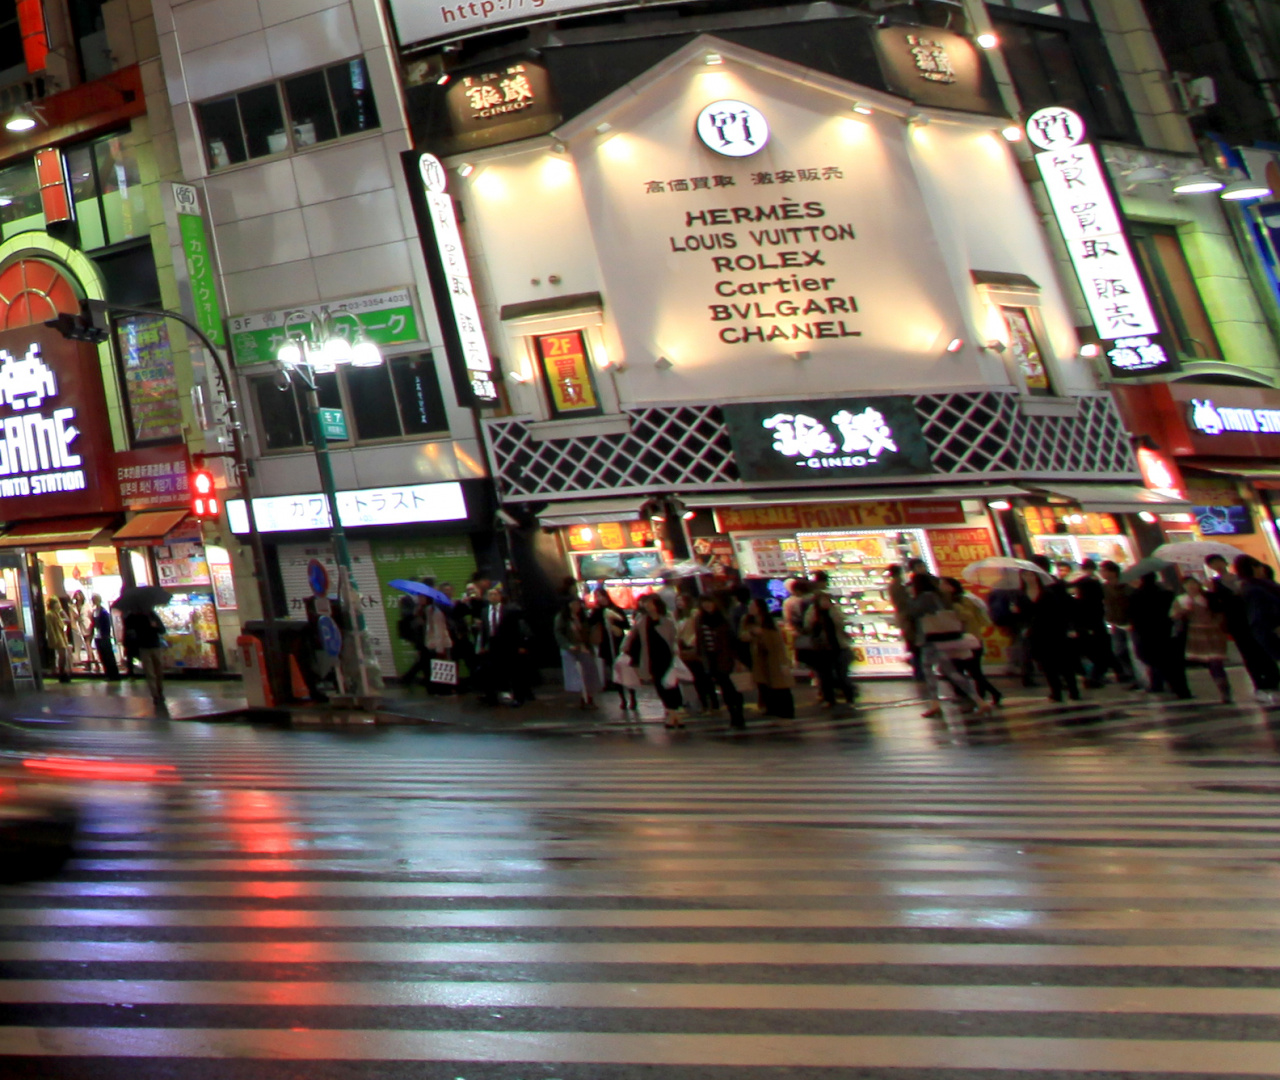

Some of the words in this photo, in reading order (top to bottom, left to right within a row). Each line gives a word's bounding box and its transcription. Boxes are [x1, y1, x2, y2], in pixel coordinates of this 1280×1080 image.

[644, 174, 736, 195] 高価買取
[750, 165, 844, 186] 激安販売
[685, 196, 826, 227] HERMÈS
[669, 232, 738, 253] LOUIS
[748, 223, 857, 248] VUITTON
[711, 249, 826, 273] ROLEX
[714, 274, 836, 298] Cartier
[346, 294, 410, 312] 03-3354-4031
[708, 295, 859, 322] BVLGARI
[234, 318, 251, 331] 3F
[718, 320, 862, 345] CHANEL
[547, 337, 571, 356] 2F
[552, 358, 587, 407] 買取
[30, 469, 87, 497] STATION
[289, 490, 424, 518] カワ・トラスト
